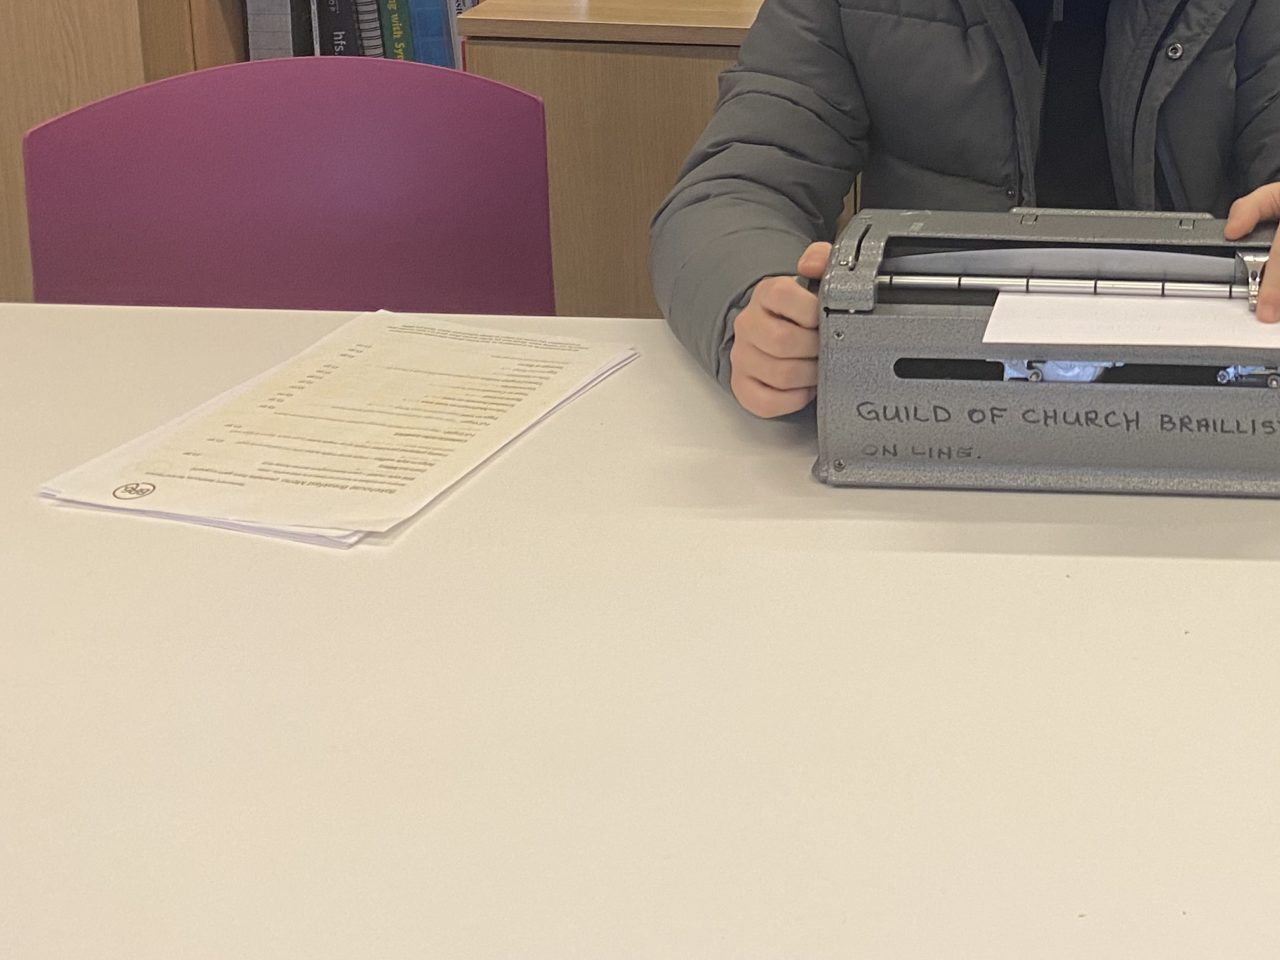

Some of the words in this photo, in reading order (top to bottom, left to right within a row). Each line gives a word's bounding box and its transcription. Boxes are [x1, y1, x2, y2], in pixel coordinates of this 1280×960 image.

[391, 14, 402, 38] with
[856, 401, 951, 423] GUILD
[968, 406, 1007, 424] OF
[1021, 408, 1140, 432] CHURCH
[861, 444, 898, 458] ON
